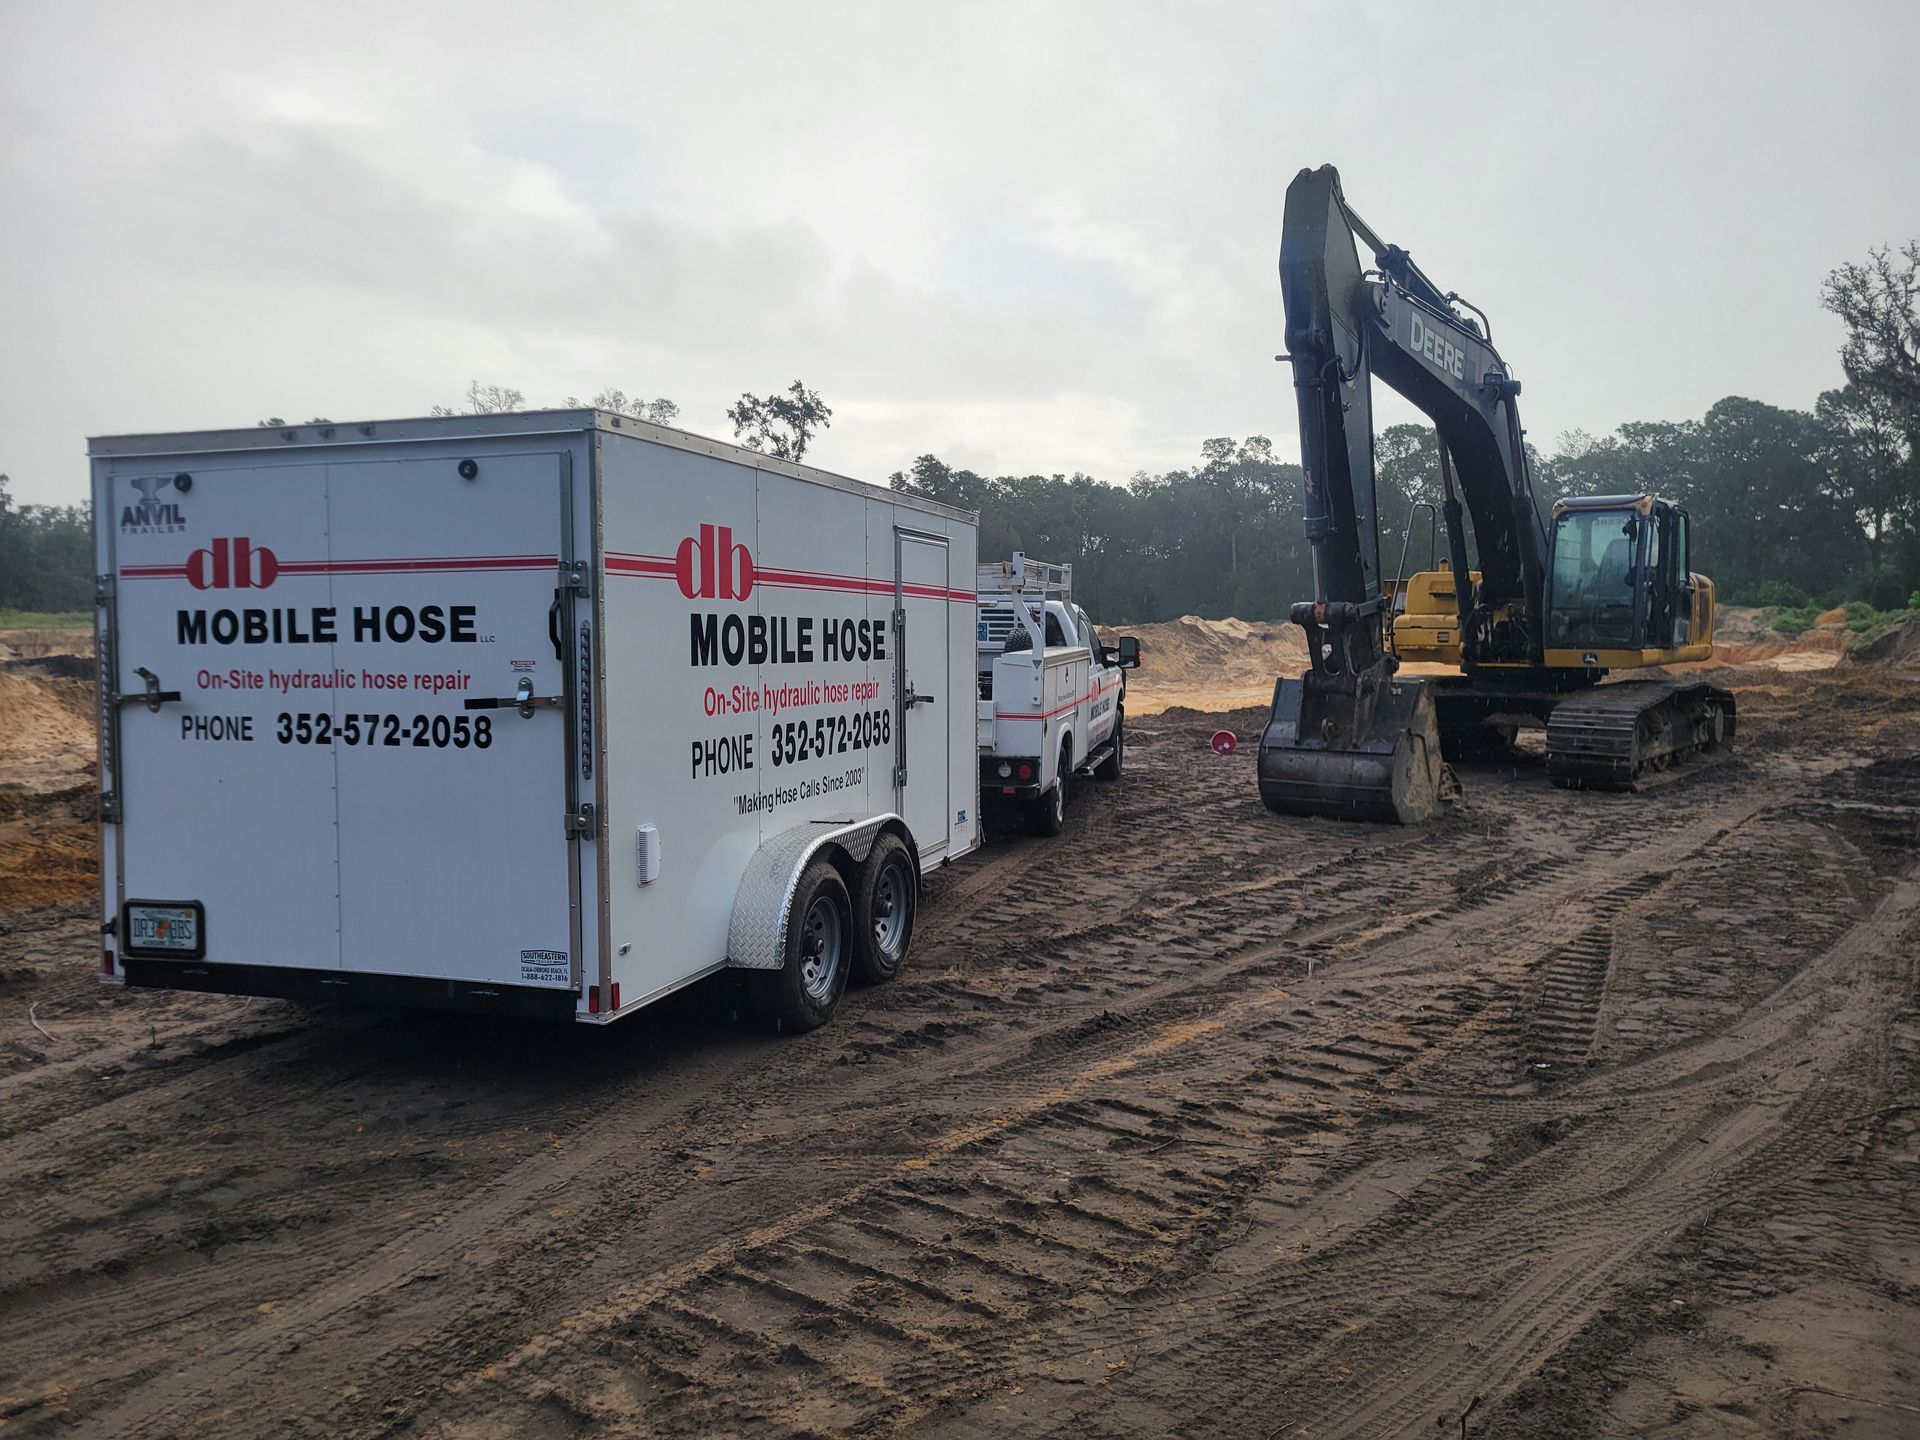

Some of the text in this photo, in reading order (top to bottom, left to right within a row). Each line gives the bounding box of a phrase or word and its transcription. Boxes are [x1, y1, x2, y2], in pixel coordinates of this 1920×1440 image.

[1410, 312, 1464, 380] DEERE
[121, 504, 186, 526] ANVIL
[121, 526, 187, 535] TRAILER
[178, 606, 496, 644] MOBILE HOSE LLC
[690, 613, 813, 666] MOBILE
[823, 618, 885, 662] HOSE
[197, 667, 471, 695] On-Site hydraulic hose repair
[704, 684, 760, 717] On-Site
[763, 683, 820, 716] hydraulic
[823, 680, 849, 703] hose
[851, 677, 880, 707] repair
[181, 712, 492, 748] PHONE 352-572-2058
[692, 708, 891, 780] PHONE 352-572-2058
[775, 783, 798, 807] Hose
[800, 777, 821, 799] Calls
[822, 773, 844, 793] Since
[521, 973, 568, 981] 1-888-622-1816
